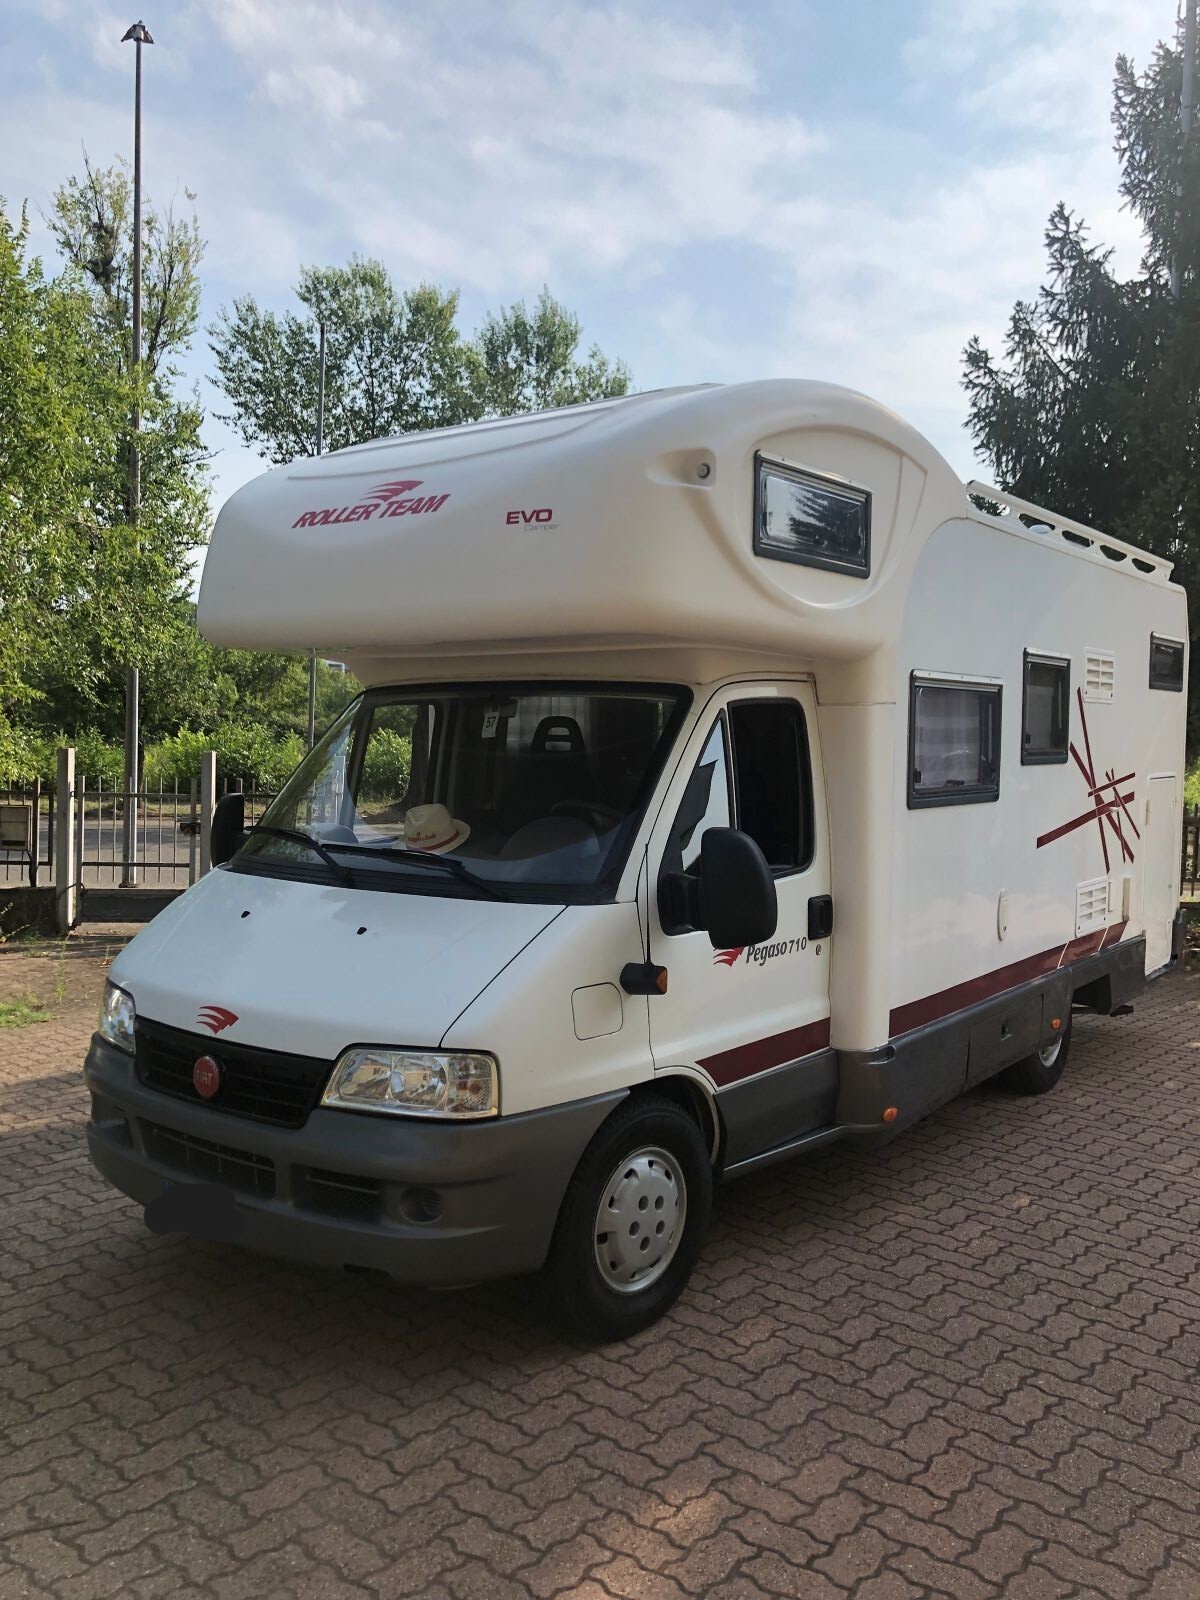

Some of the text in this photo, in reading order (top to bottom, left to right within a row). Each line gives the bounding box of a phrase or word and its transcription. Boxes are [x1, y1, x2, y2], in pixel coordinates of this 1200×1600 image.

[291, 493, 452, 529] ROLLER TEAM
[506, 508, 553, 525] EVO
[485, 716, 497, 729] 57
[745, 936, 807, 967] Pegaso 710
